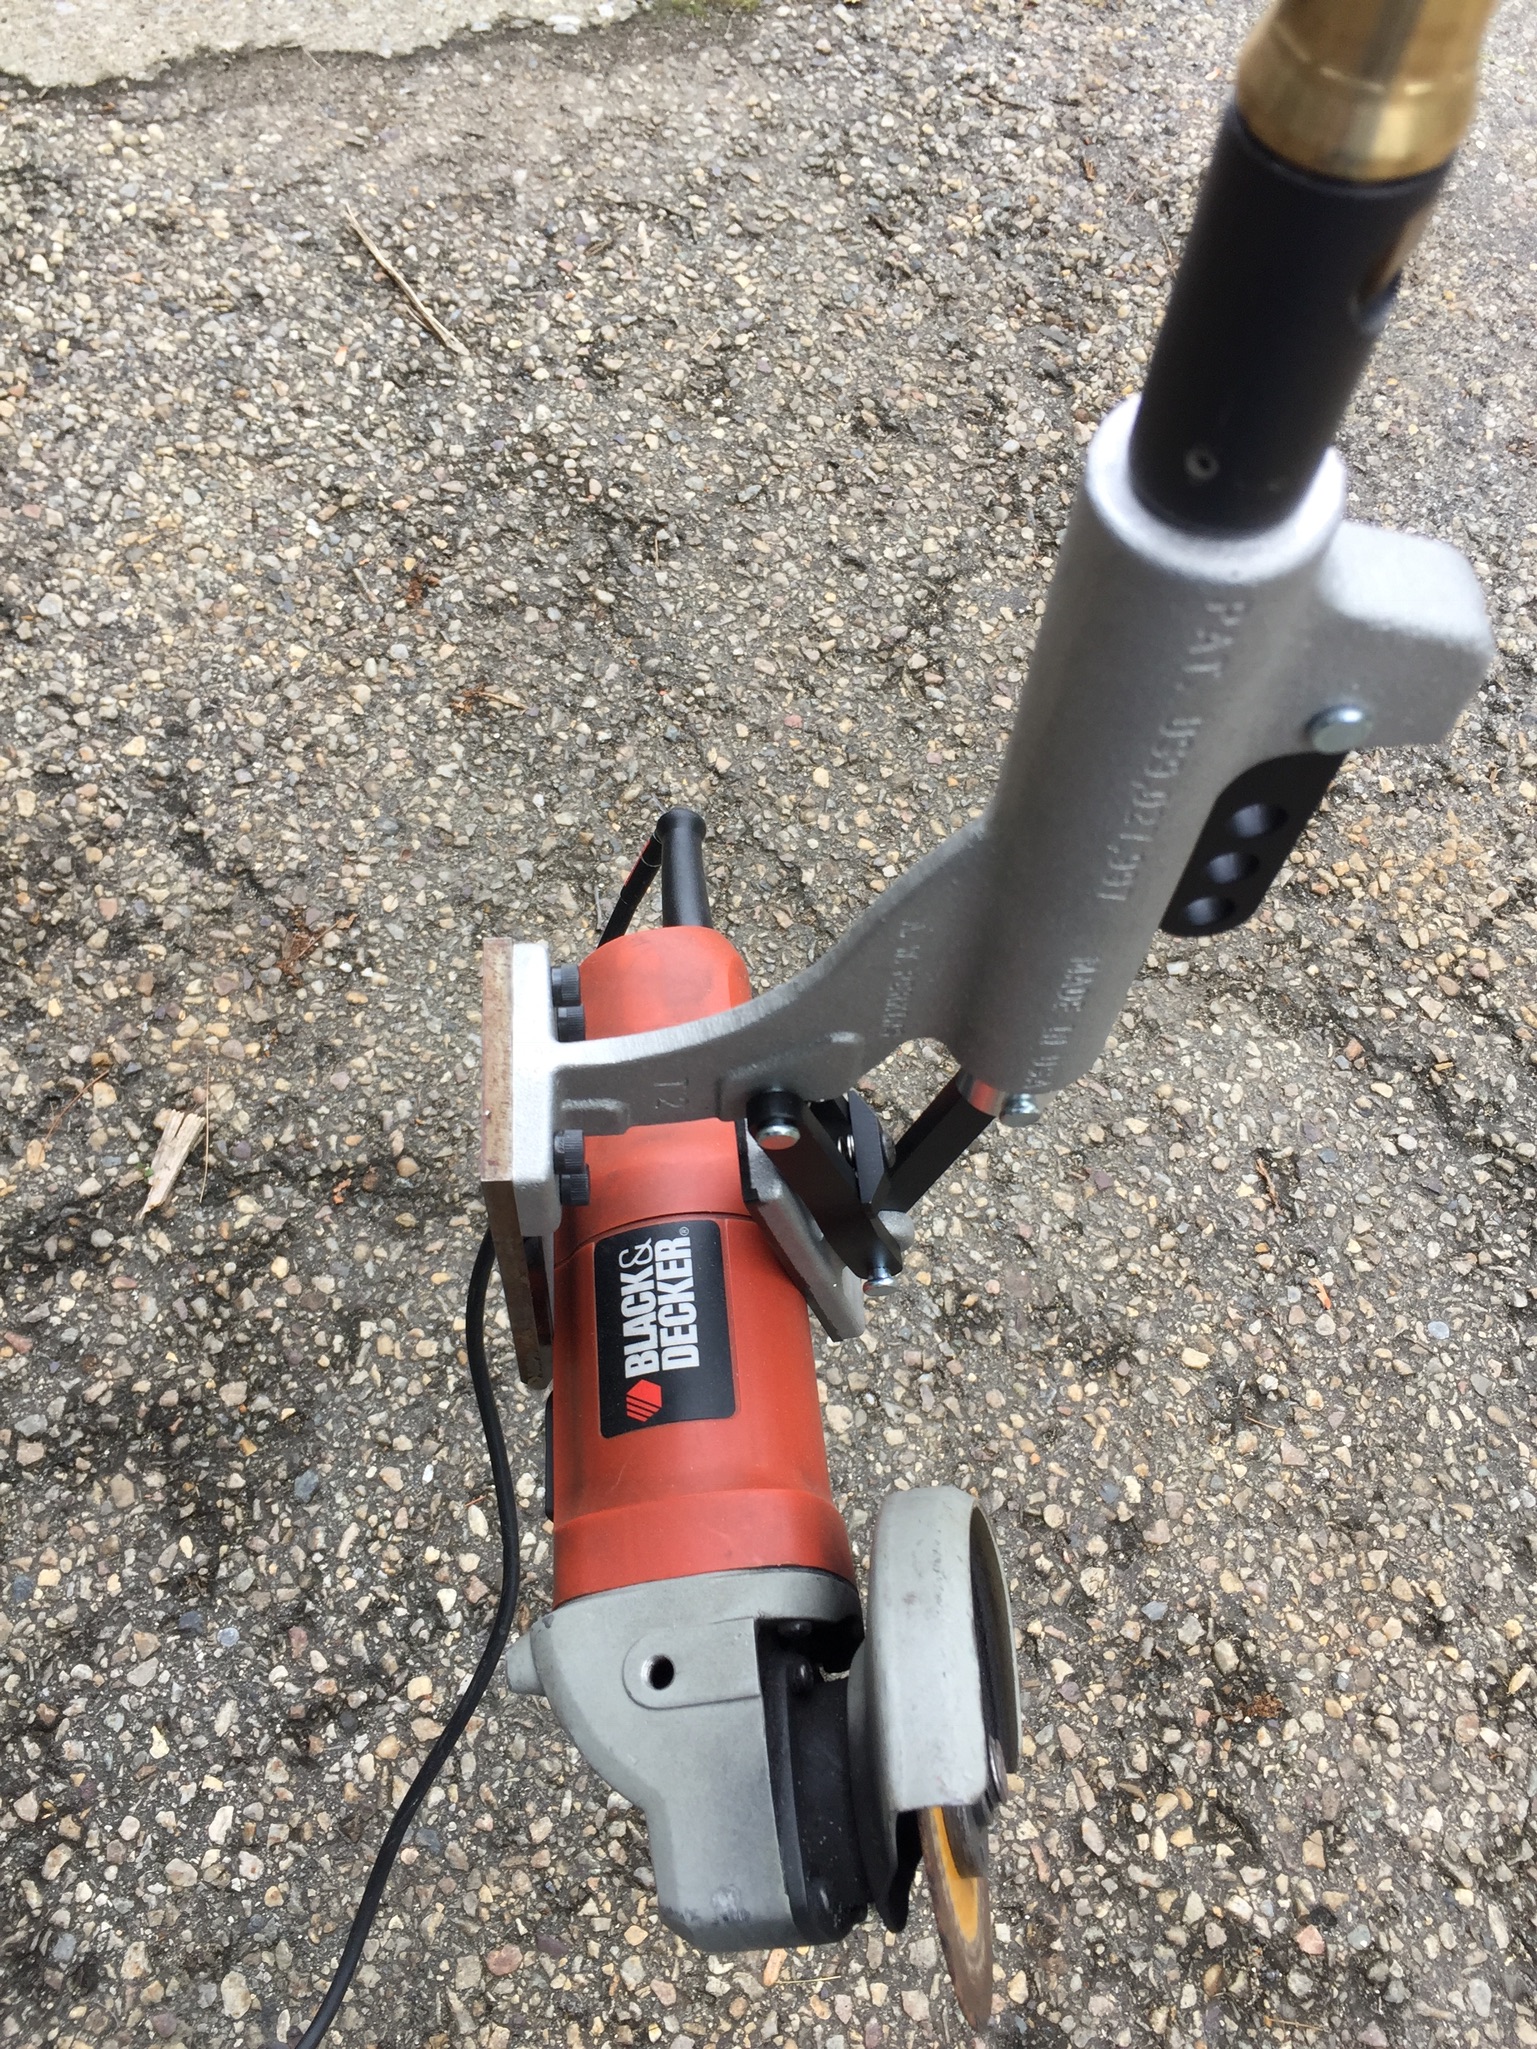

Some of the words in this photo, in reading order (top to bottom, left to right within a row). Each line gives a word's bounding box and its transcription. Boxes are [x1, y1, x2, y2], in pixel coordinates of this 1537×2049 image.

[1055, 956, 1099, 1013] MADE
[618, 1237, 654, 1269] &
[620, 1265, 660, 1379] BLACK
